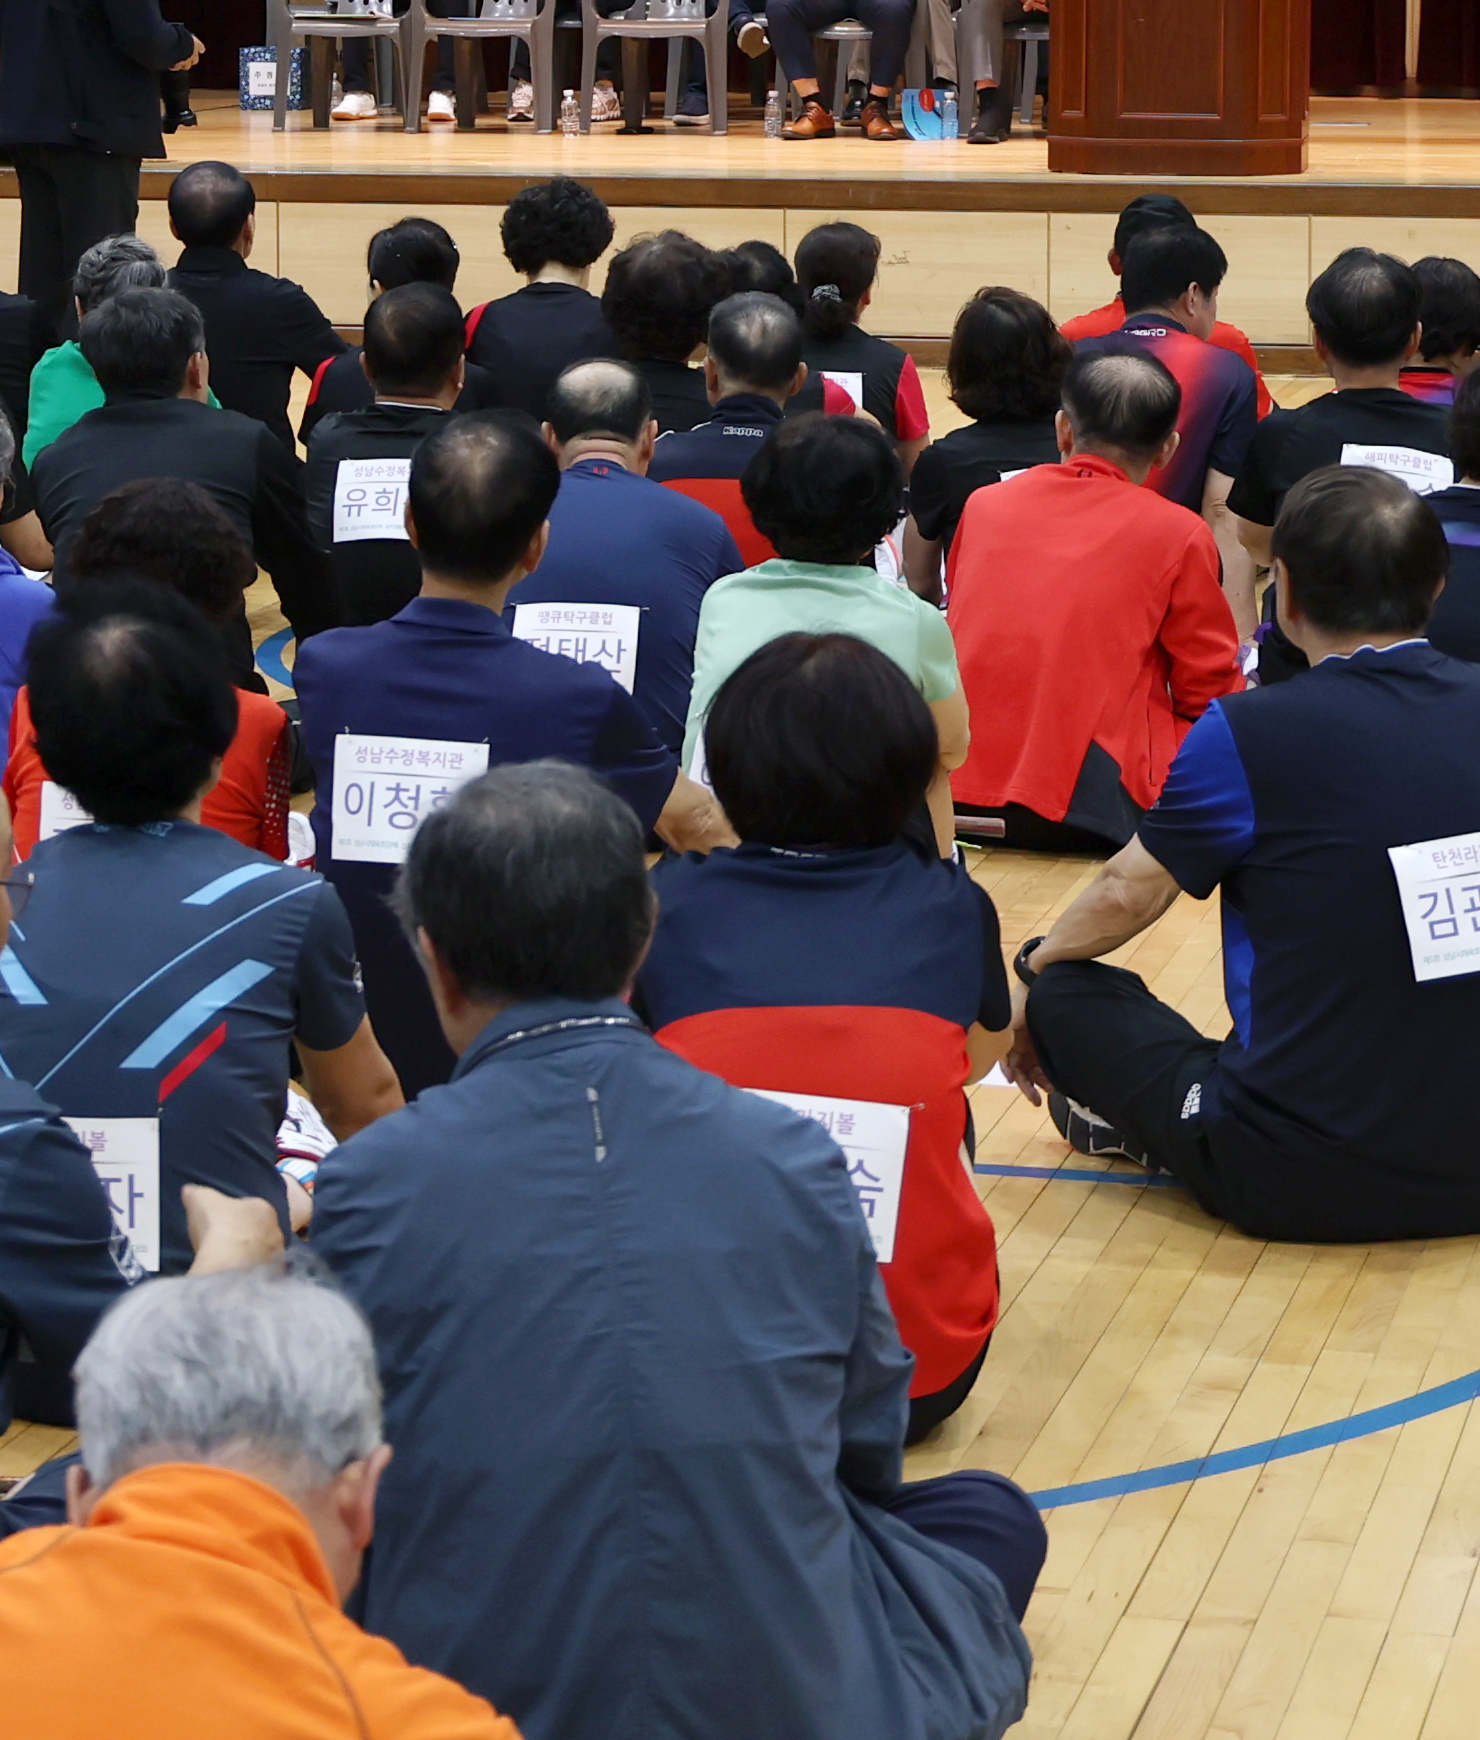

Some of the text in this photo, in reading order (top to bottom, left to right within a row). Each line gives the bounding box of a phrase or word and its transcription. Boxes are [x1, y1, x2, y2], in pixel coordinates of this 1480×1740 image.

[1125, 328, 1167, 338] AGRO
[723, 426, 763, 438] Kappa
[1365, 451, 1433, 471] 해피탁구클럽
[354, 465, 410, 478] 성남수정복
[538, 610, 614, 626] 땡큐탁구클럽
[355, 745, 464, 771] 성남수정복지관
